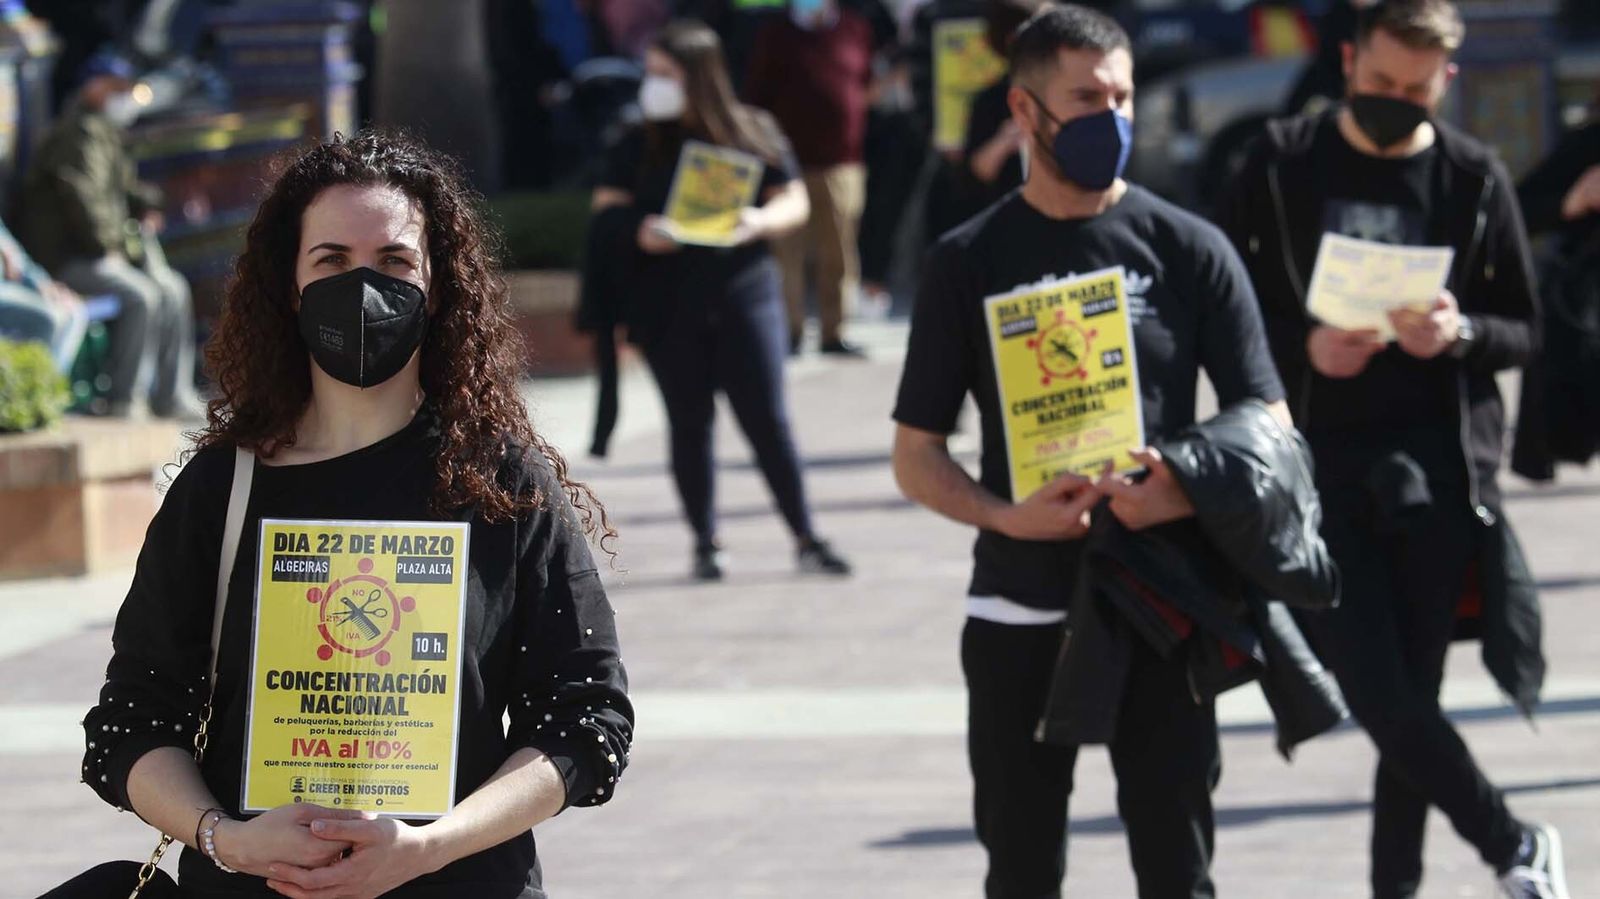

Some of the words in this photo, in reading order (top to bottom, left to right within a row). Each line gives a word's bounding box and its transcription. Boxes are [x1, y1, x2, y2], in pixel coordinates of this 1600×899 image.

[274, 532, 310, 552] DIA
[317, 533, 344, 553] 22
[350, 534, 376, 555] DE
[381, 535, 455, 555] MARZO
[274, 560, 328, 573] ALGECIRAS
[397, 563, 426, 574] PLAZA
[429, 563, 452, 575] ALTA
[346, 632, 360, 640] IVA
[415, 638, 428, 653] 10
[433, 638, 445, 653] h.
[266, 669, 447, 694] CONCENTRACIÓN
[300, 694, 409, 716] NACIONAL
[287, 717, 341, 727] peluquerías,
[343, 718, 386, 727] barberías
[387, 720, 393, 728] y
[394, 719, 434, 728] estéticas
[309, 728, 326, 736] por
[327, 727, 336, 735] la
[337, 728, 381, 736] reducción
[291, 738, 332, 758] IVA
[338, 739, 359, 759] al
[366, 740, 412, 760] 10%
[264, 760, 280, 769] que
[281, 760, 312, 768] merece
[314, 761, 345, 769] nuestro
[375, 763, 390, 771] por
[405, 763, 439, 771] esencial
[309, 783, 340, 794] CREER
[342, 784, 356, 795] EN
[357, 784, 410, 796] NOSOTROS
